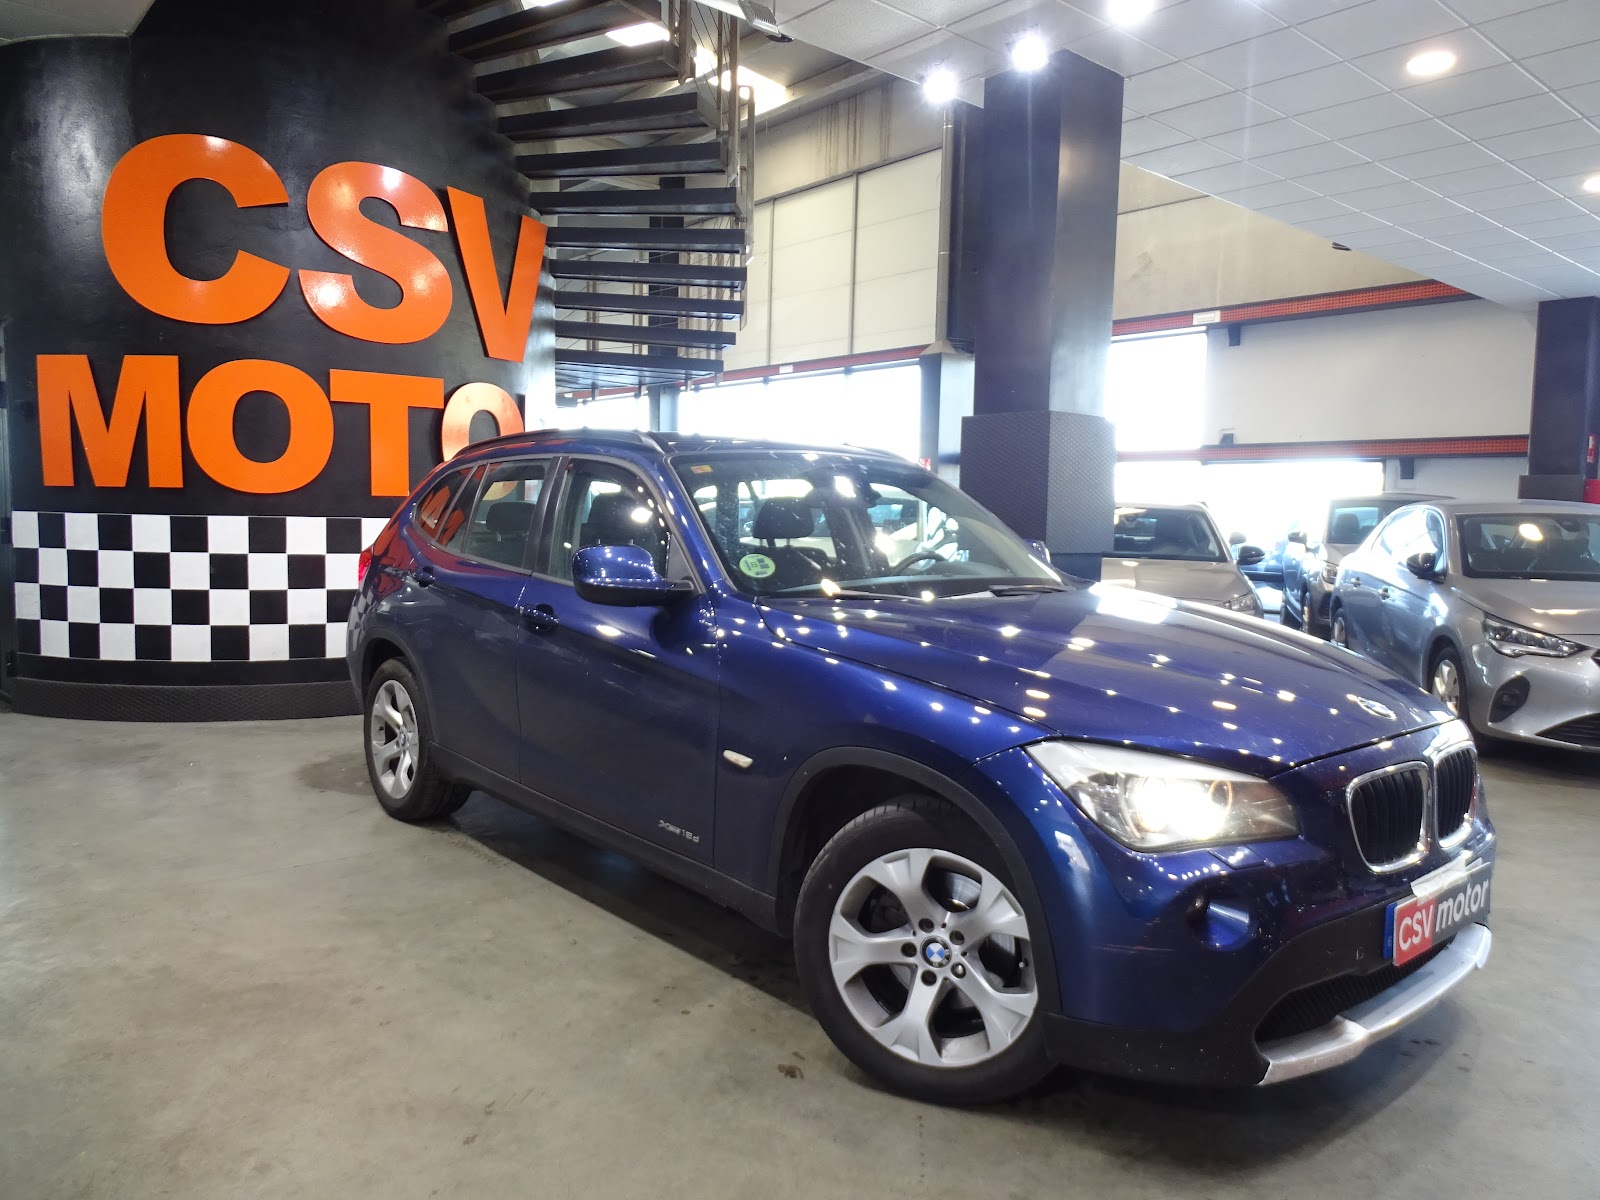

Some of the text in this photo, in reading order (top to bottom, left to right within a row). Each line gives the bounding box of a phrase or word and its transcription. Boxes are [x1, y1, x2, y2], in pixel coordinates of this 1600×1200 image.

[102, 134, 548, 363] CSV
[36, 354, 526, 497] MOTO
[1398, 878, 1489, 951] CSV motor
